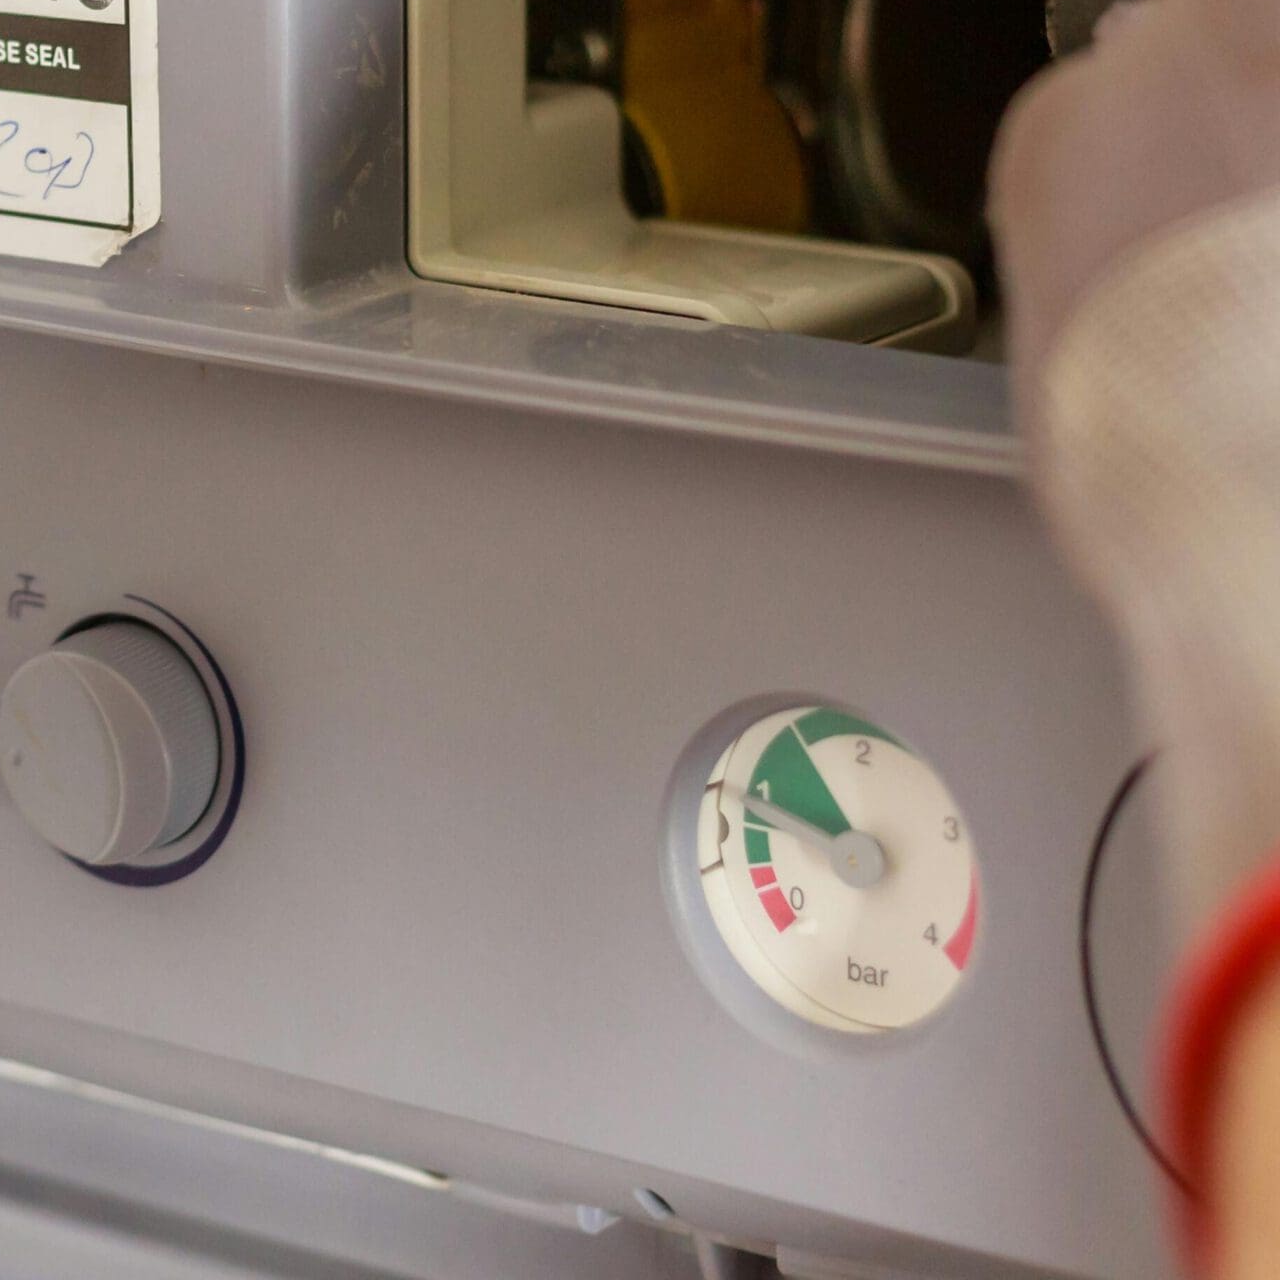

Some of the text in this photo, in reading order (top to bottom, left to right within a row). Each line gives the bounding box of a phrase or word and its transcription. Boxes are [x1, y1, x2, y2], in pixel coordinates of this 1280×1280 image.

[25, 43, 81, 70] SEAL
[855, 739, 872, 767] 2
[756, 779, 770, 802] 1
[943, 816, 960, 842] 3
[789, 886, 805, 910] 0
[922, 922, 939, 947] 4
[847, 958, 889, 988] bar
